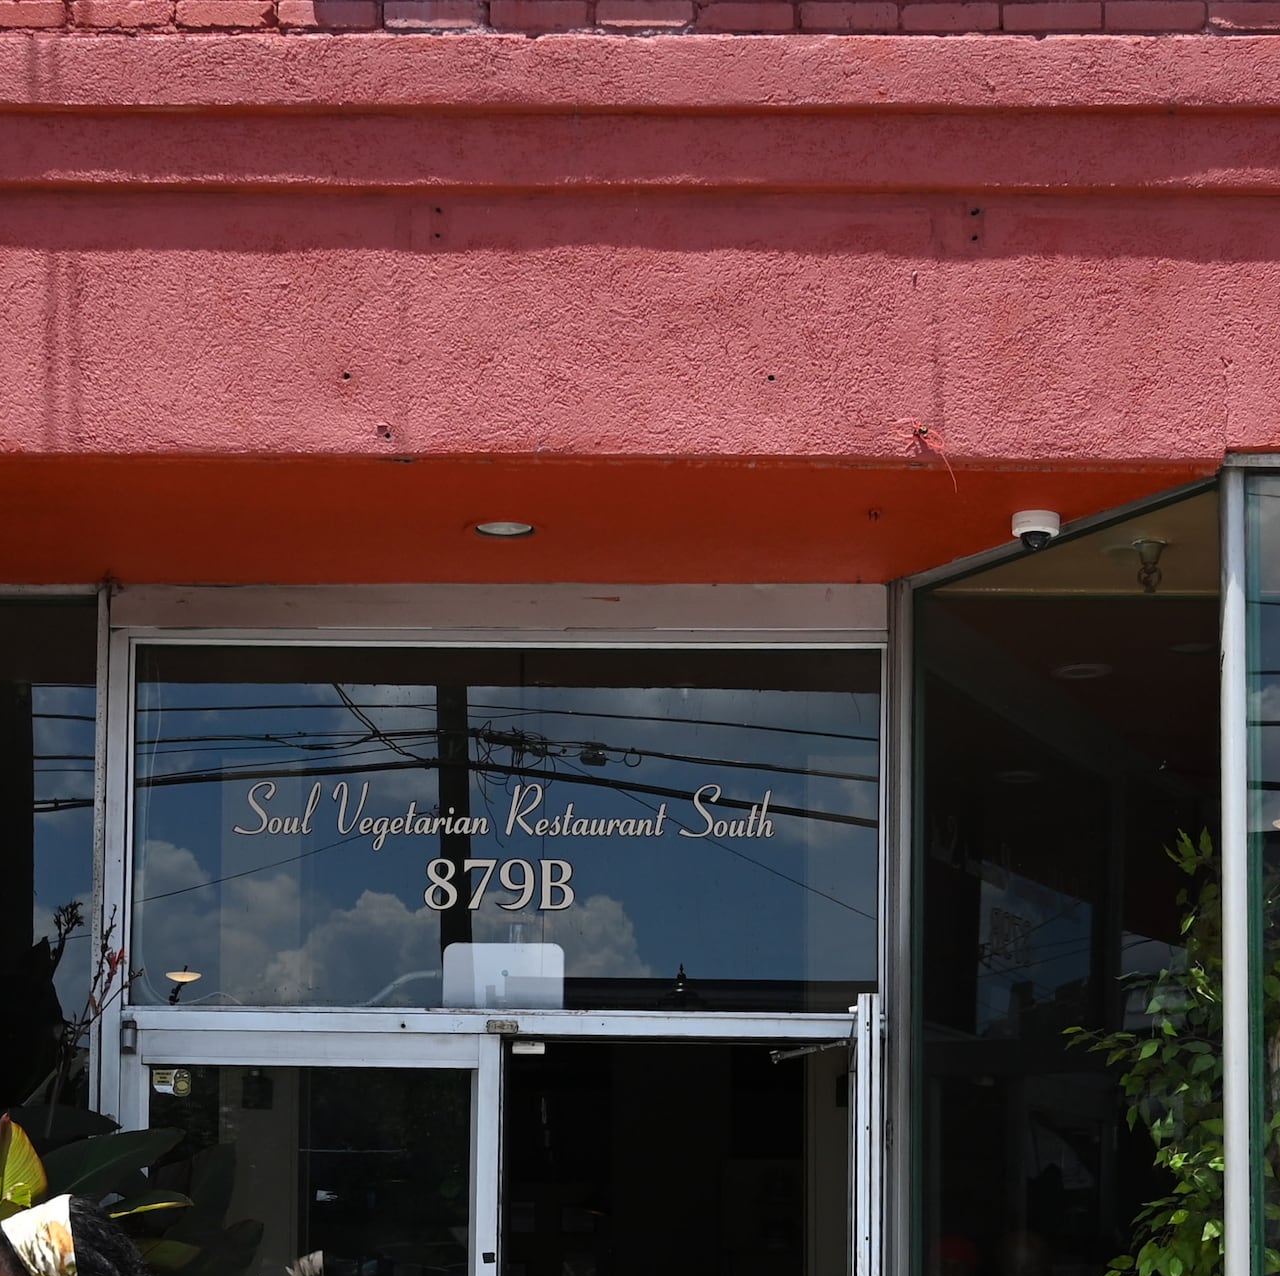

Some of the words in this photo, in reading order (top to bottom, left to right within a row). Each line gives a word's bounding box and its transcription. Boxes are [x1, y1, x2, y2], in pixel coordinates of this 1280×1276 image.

[232, 781, 322, 835] Soul
[331, 781, 490, 852] Vegetarian
[505, 783, 668, 837] Restaurant
[678, 783, 776, 838] South
[423, 858, 576, 912] 879B
